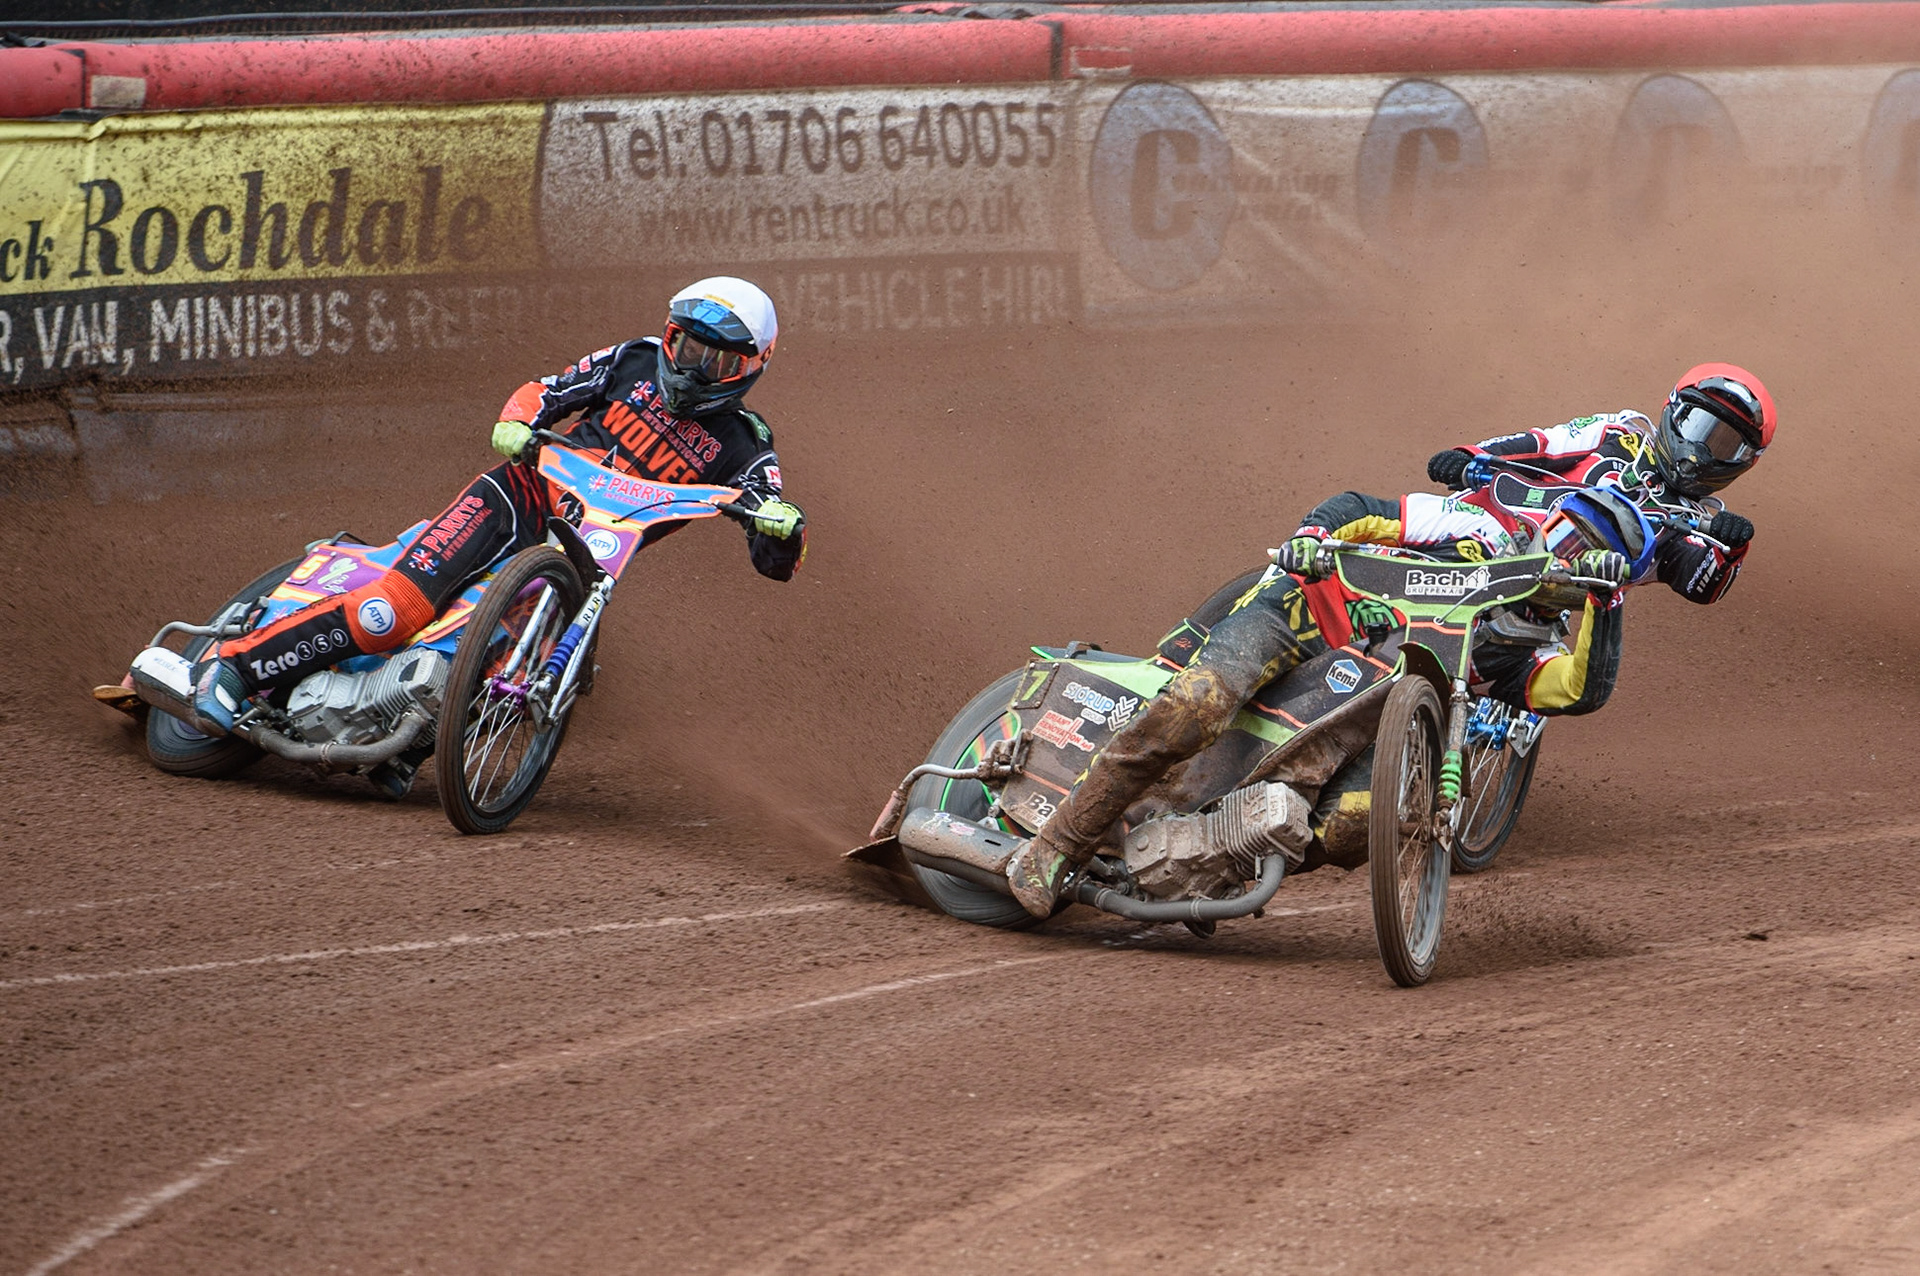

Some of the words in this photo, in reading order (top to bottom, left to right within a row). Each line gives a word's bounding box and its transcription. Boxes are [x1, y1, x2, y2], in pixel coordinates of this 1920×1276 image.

[583, 110, 687, 181] Tel:
[701, 106, 864, 177] 01706
[878, 101, 1057, 171] 640055
[69, 165, 491, 279] Rochdale
[33, 300, 135, 376] VAN,
[150, 290, 351, 363] MINIBUS
[604, 492, 667, 515] INTERNATINAL
[608, 477, 676, 507] PARRYS
[421, 495, 485, 553] PARRYS
[1408, 572, 1464, 586] Bach
[367, 606, 387, 628] ATPI
[1021, 670, 1050, 701] 7
[1328, 665, 1357, 688] Kema
[1027, 792, 1055, 818] Ba
